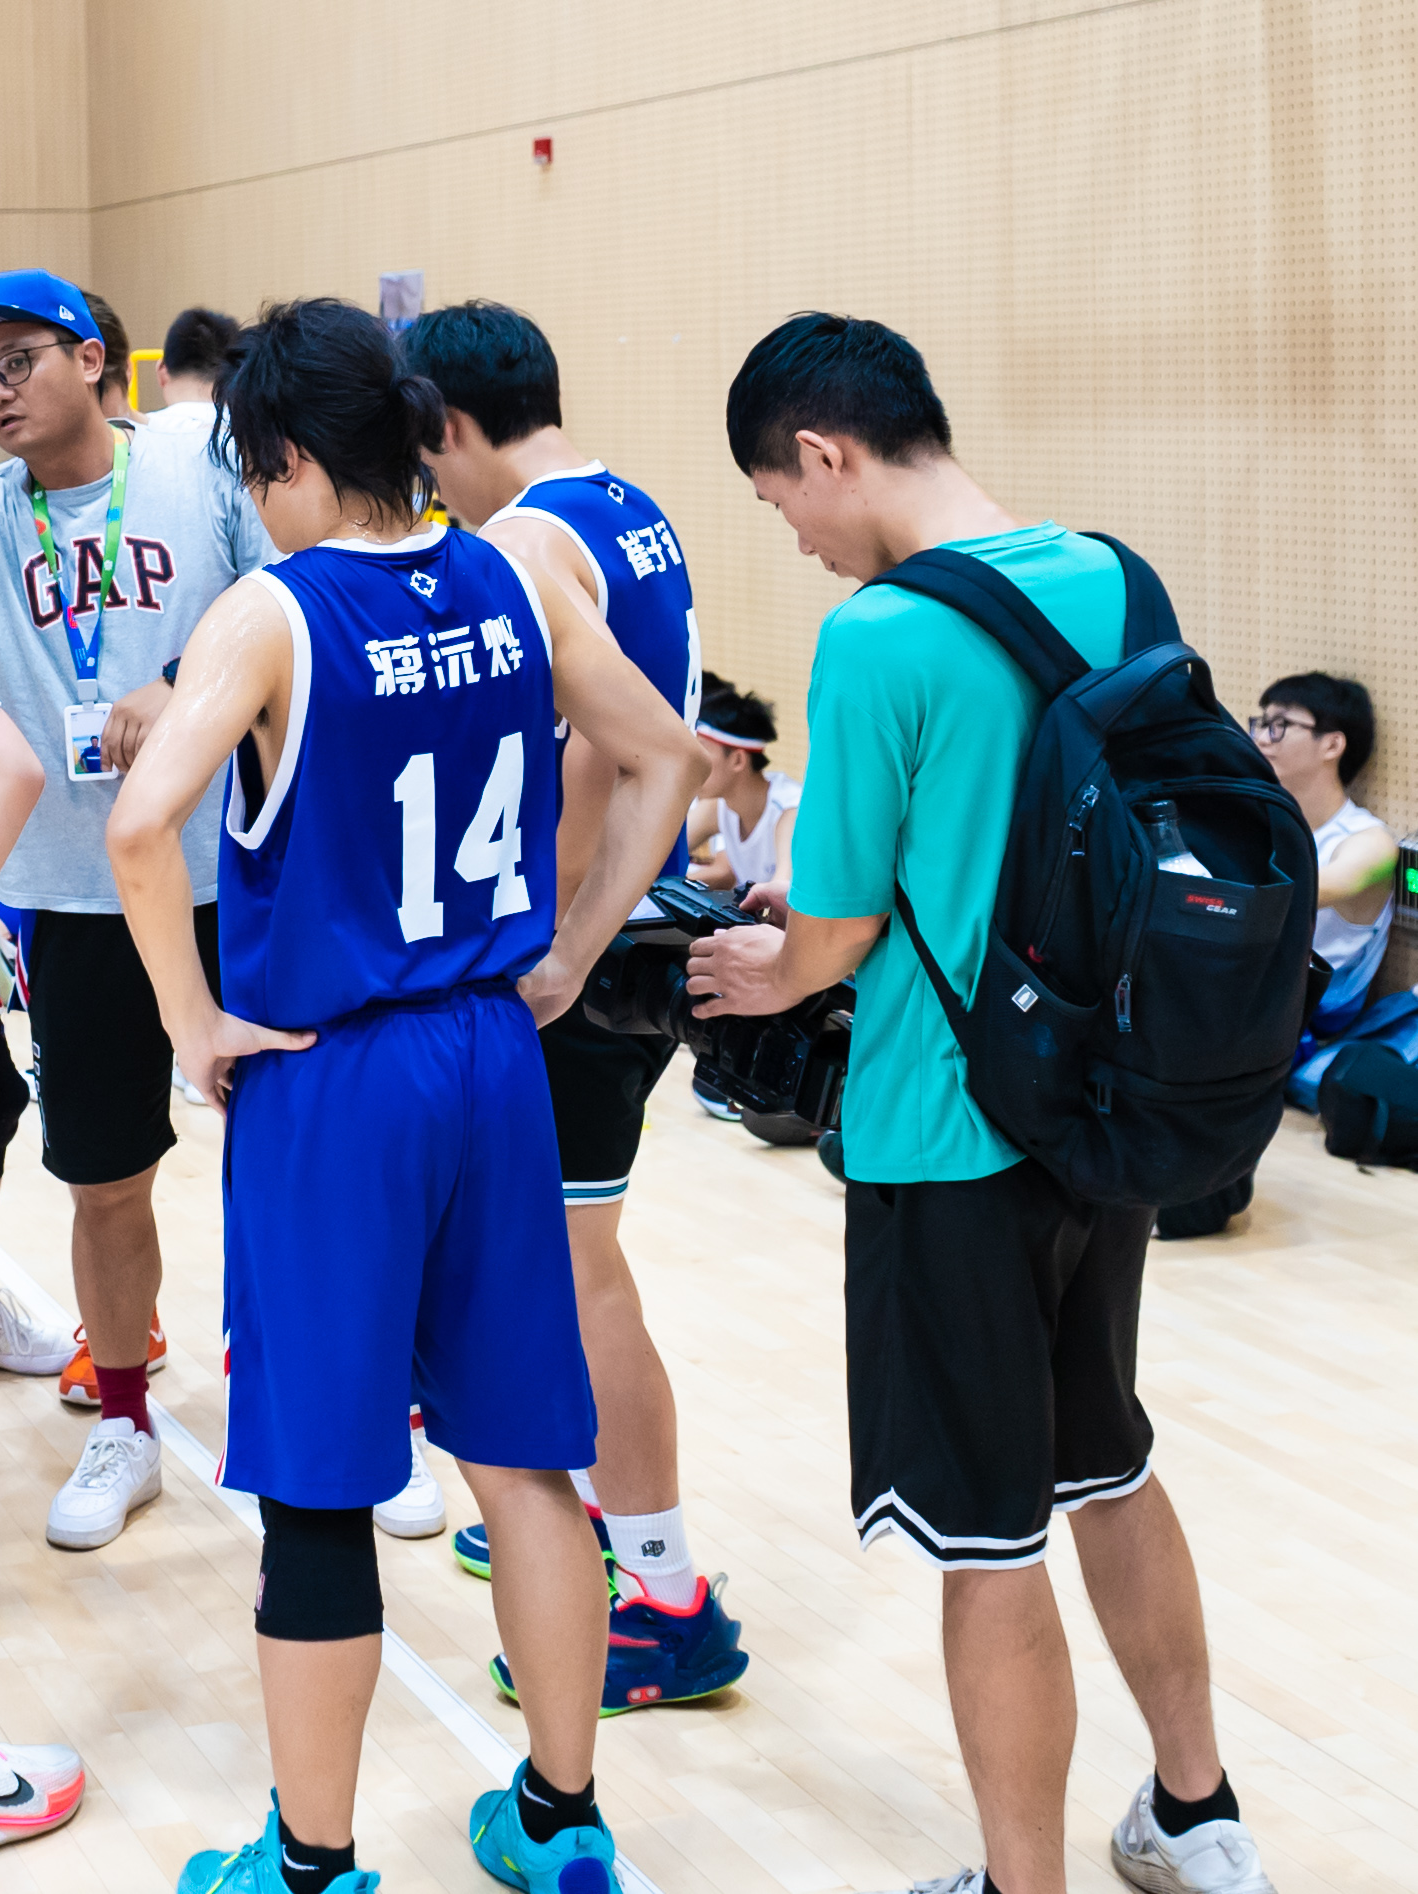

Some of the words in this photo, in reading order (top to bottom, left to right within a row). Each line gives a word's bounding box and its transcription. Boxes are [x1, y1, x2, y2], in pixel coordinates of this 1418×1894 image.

[22, 533, 178, 631] GAP
[365, 615, 523, 697] 蒋沅烨
[393, 731, 531, 943] 14
[1206, 904, 1238, 916] GEAR
